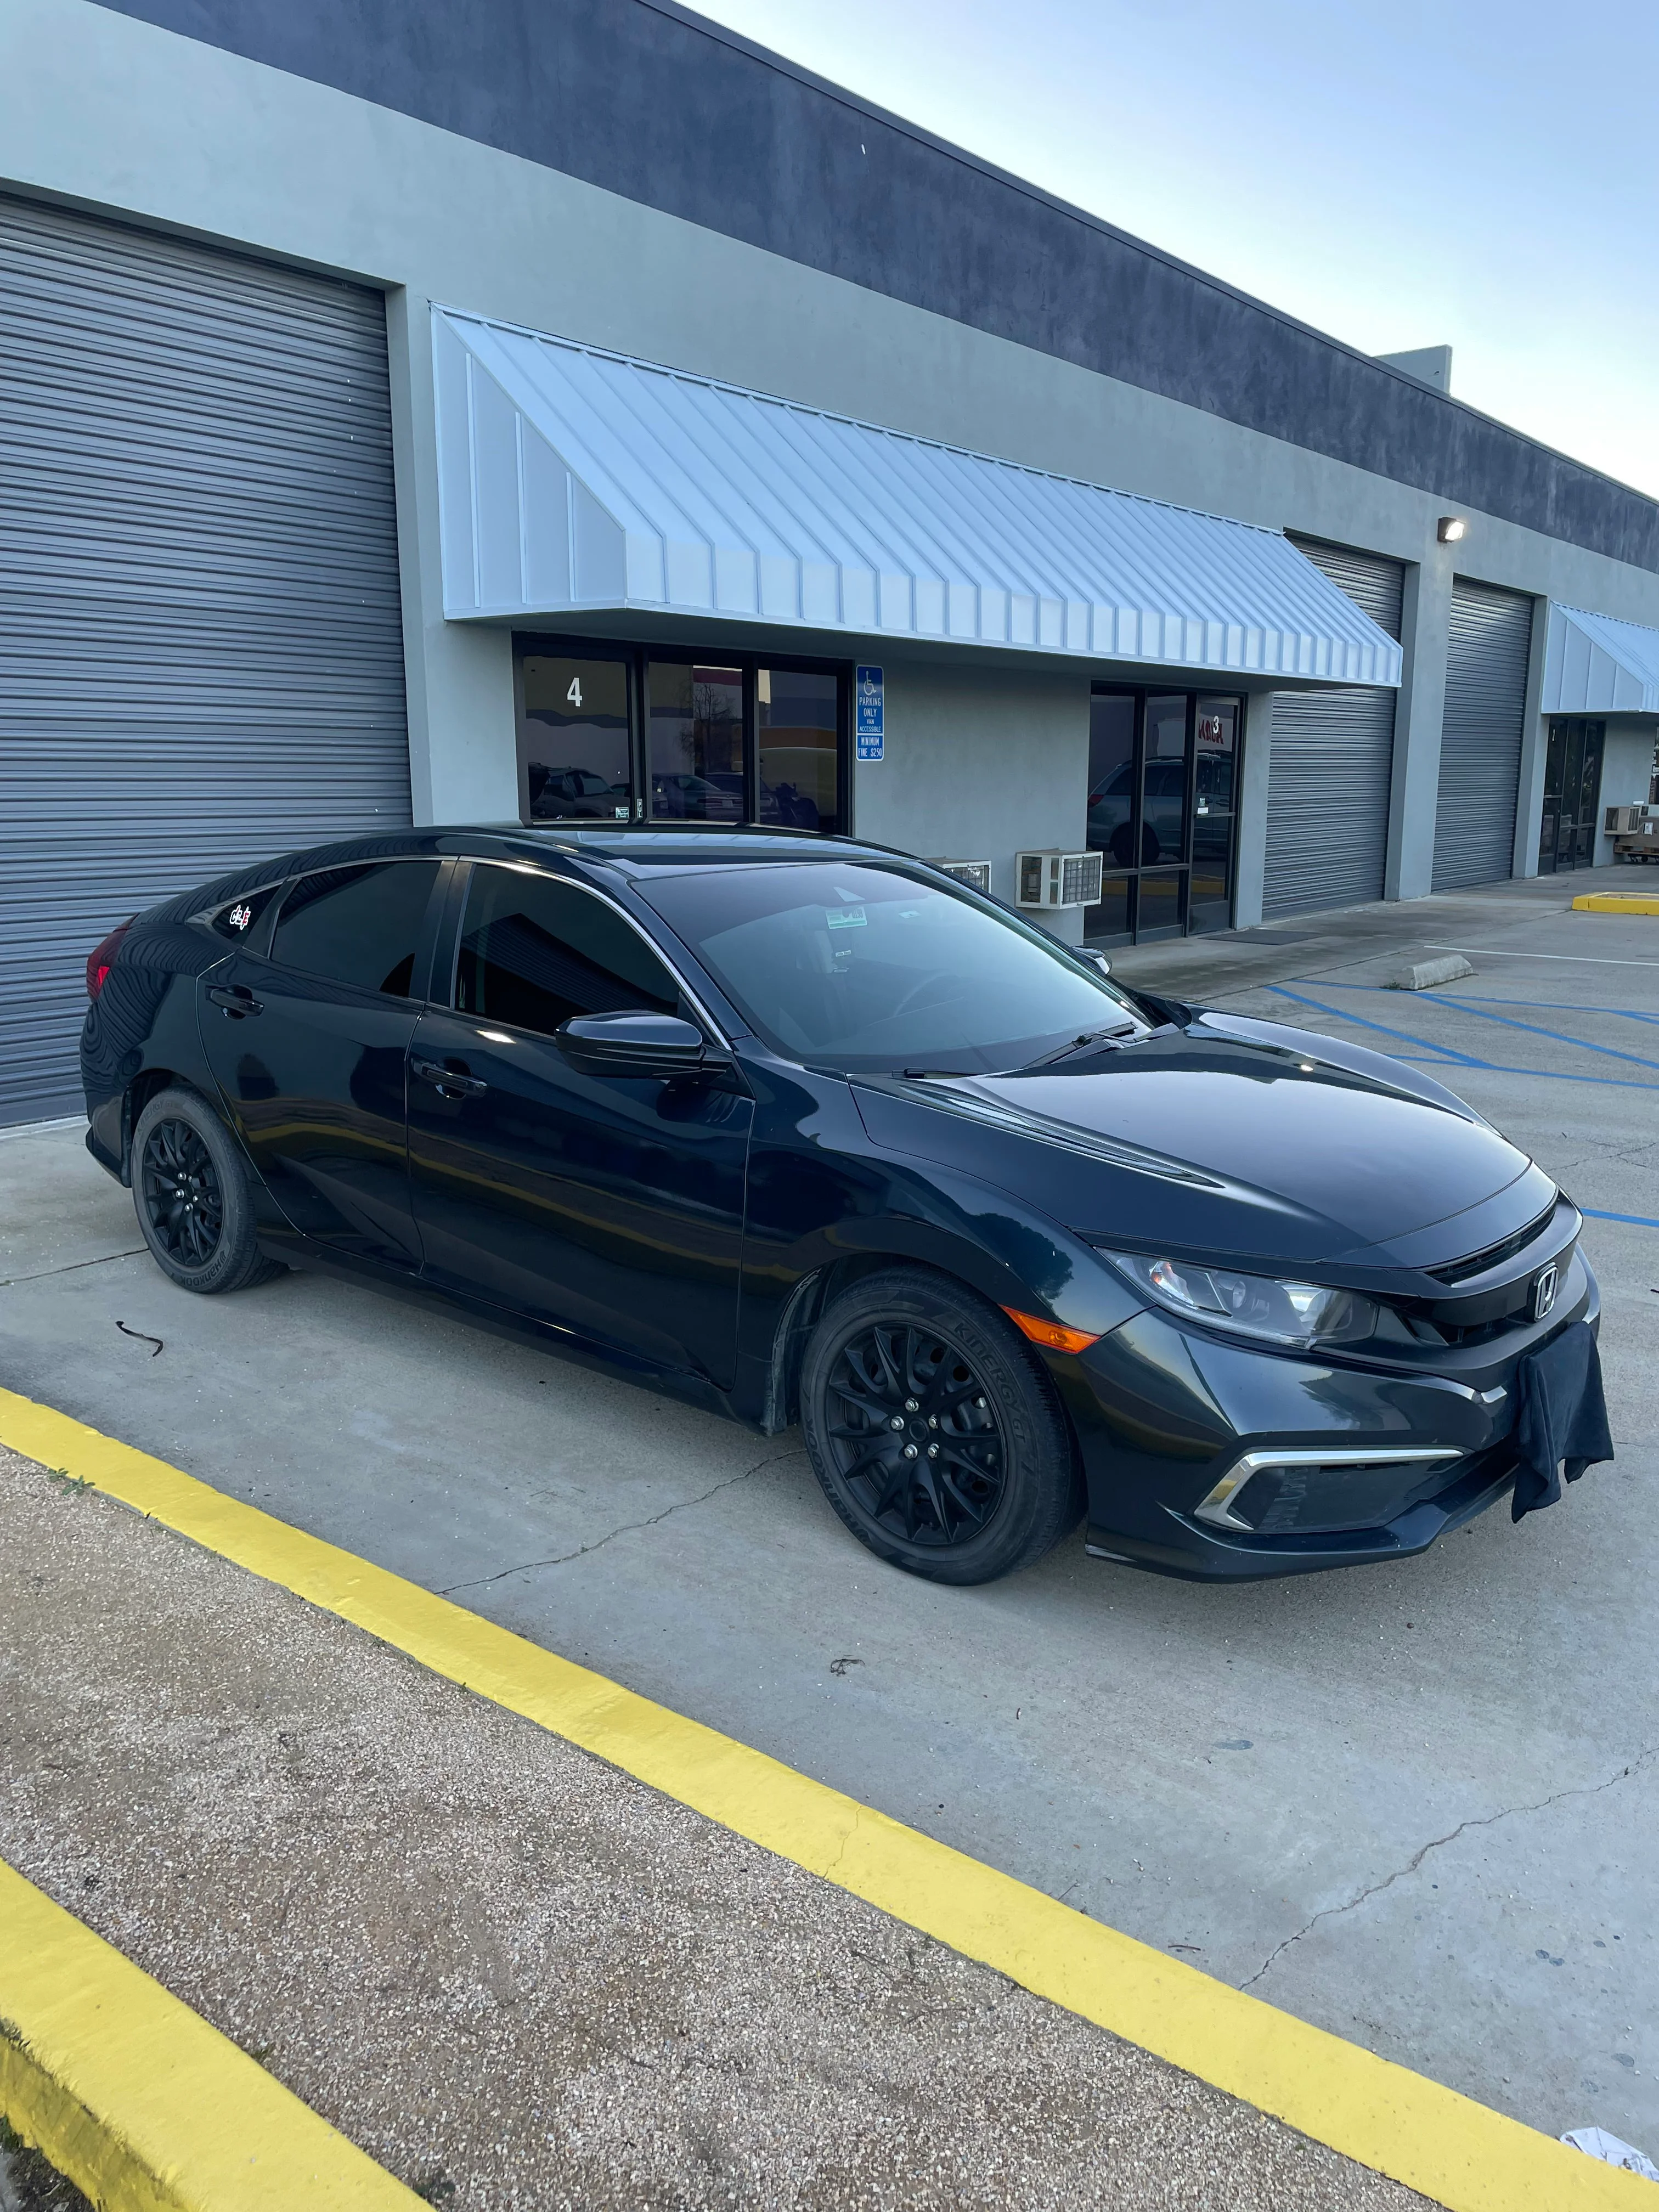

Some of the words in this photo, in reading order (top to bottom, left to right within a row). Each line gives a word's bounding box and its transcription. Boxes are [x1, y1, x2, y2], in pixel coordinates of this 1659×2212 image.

[567, 677, 583, 707] 4
[859, 696, 881, 707] PARKING
[864, 707, 877, 717] ONLY
[1213, 715, 1220, 734] 3
[861, 737, 879, 746] MINIMUM
[858, 748, 867, 757] FINE
[870, 747, 882, 757] $250
